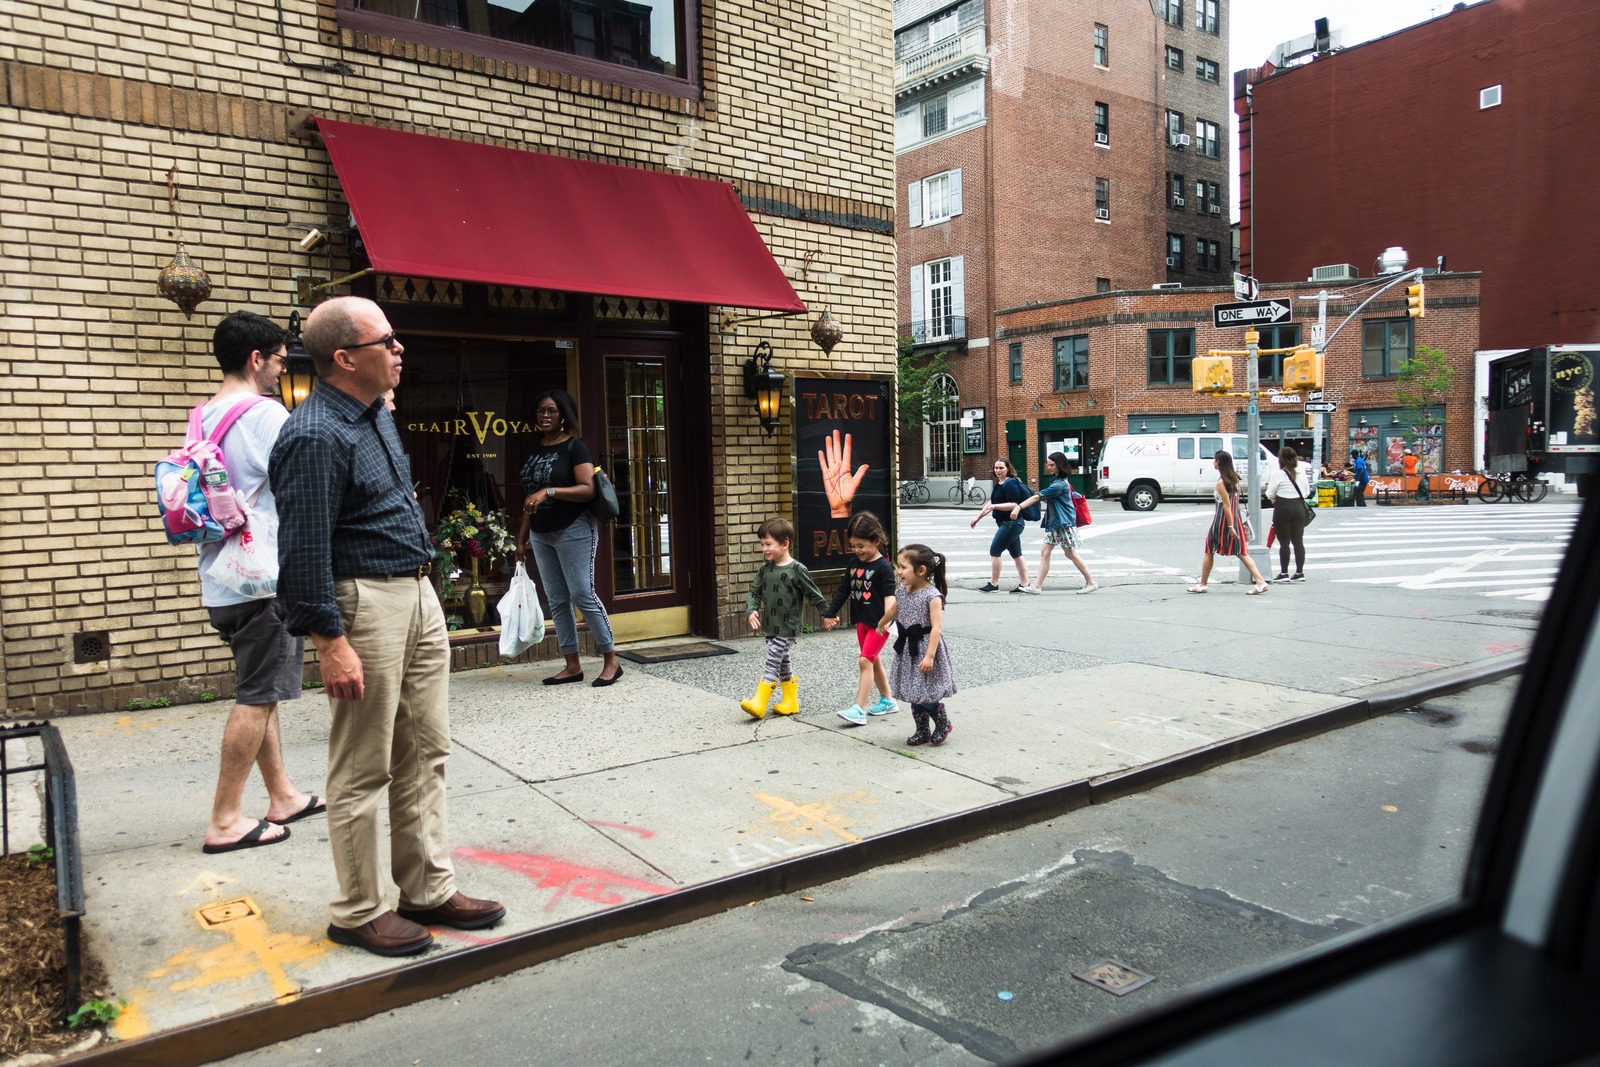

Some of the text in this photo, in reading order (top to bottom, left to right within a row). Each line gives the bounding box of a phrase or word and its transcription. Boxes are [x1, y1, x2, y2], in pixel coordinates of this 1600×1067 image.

[1221, 306, 1280, 320] ONE WAY
[1556, 366, 1582, 380] nyc
[802, 392, 878, 420] TAROT
[407, 411, 543, 445] CLAIRVOYAN
[812, 528, 855, 557] PAL
[773, 584, 779, 592] H
